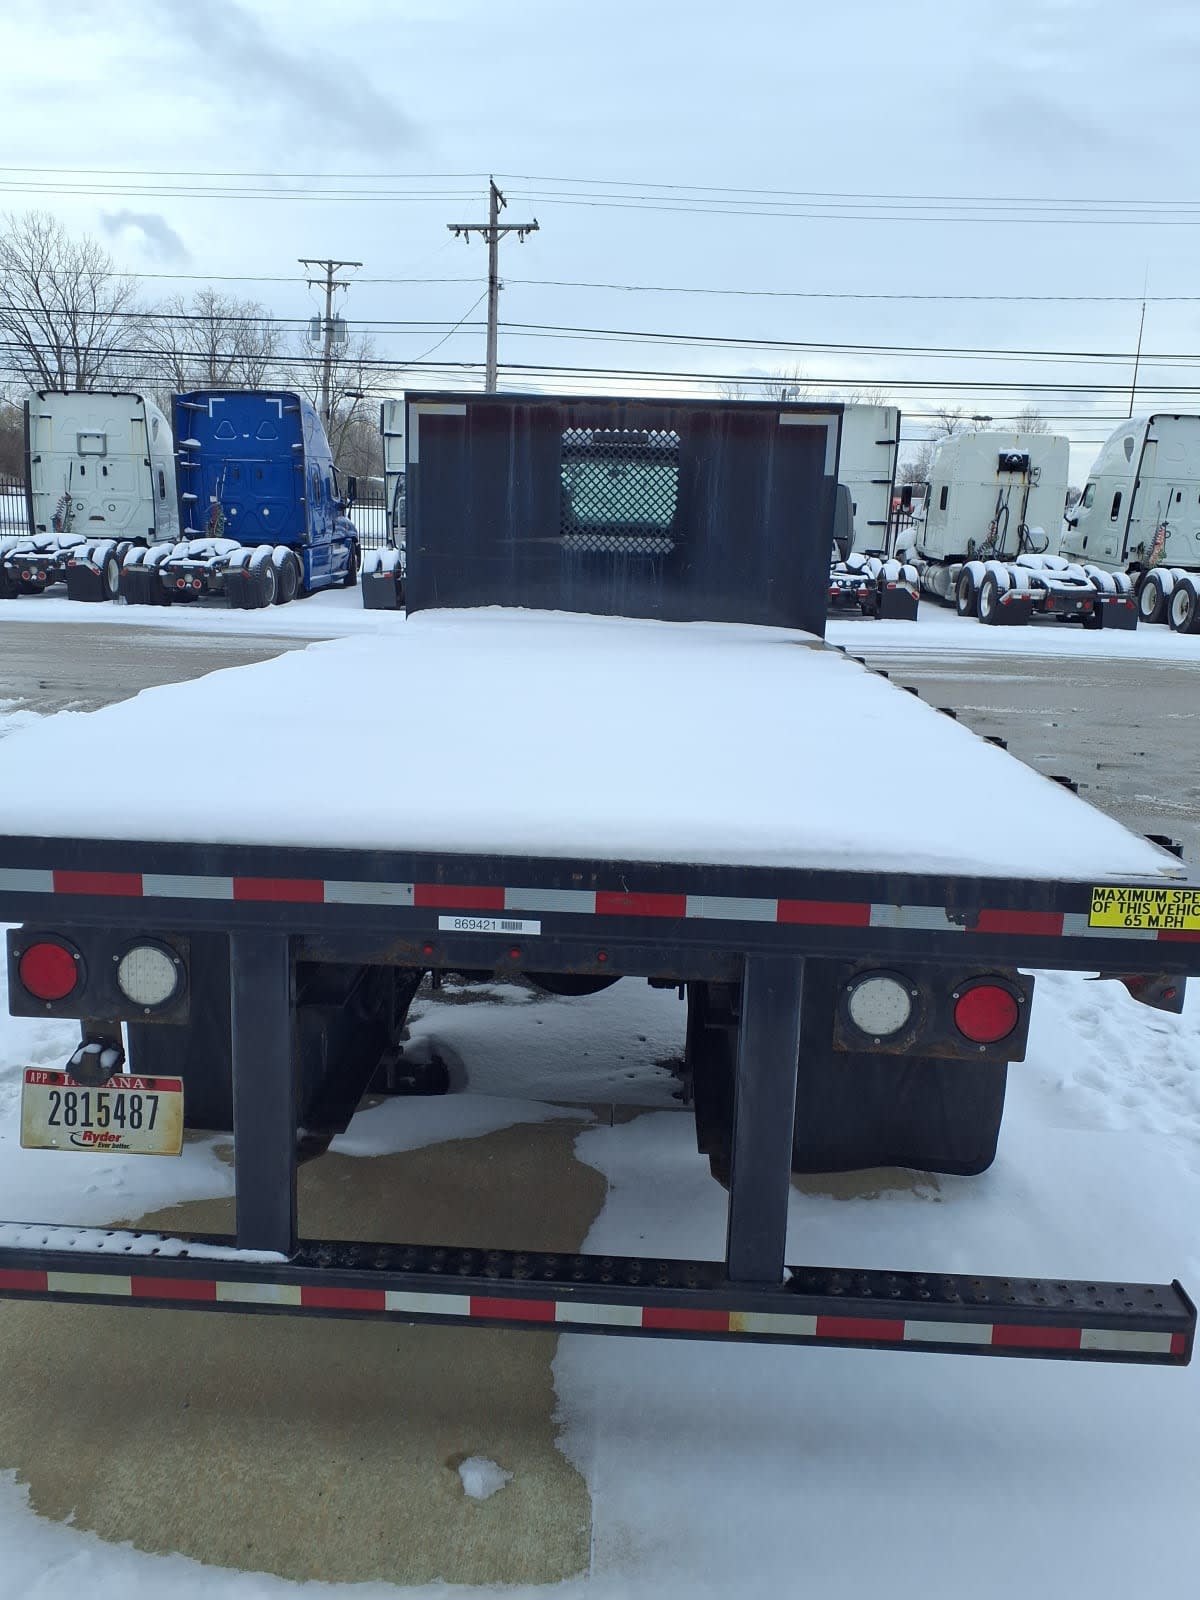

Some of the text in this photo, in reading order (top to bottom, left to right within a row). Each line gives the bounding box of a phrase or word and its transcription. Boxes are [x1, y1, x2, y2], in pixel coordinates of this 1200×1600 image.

[1093, 888, 1200, 904] MAXIMUM SPE
[1092, 901, 1200, 916] OF THIS VEHIC
[454, 918, 496, 931] 869421
[1124, 914, 1142, 926] 65
[30, 1071, 47, 1083] APP
[63, 1074, 145, 1089] IANA
[48, 1090, 159, 1130] 2815487
[82, 1130, 122, 1144] Ryder
[97, 1141, 111, 1149] Ever
